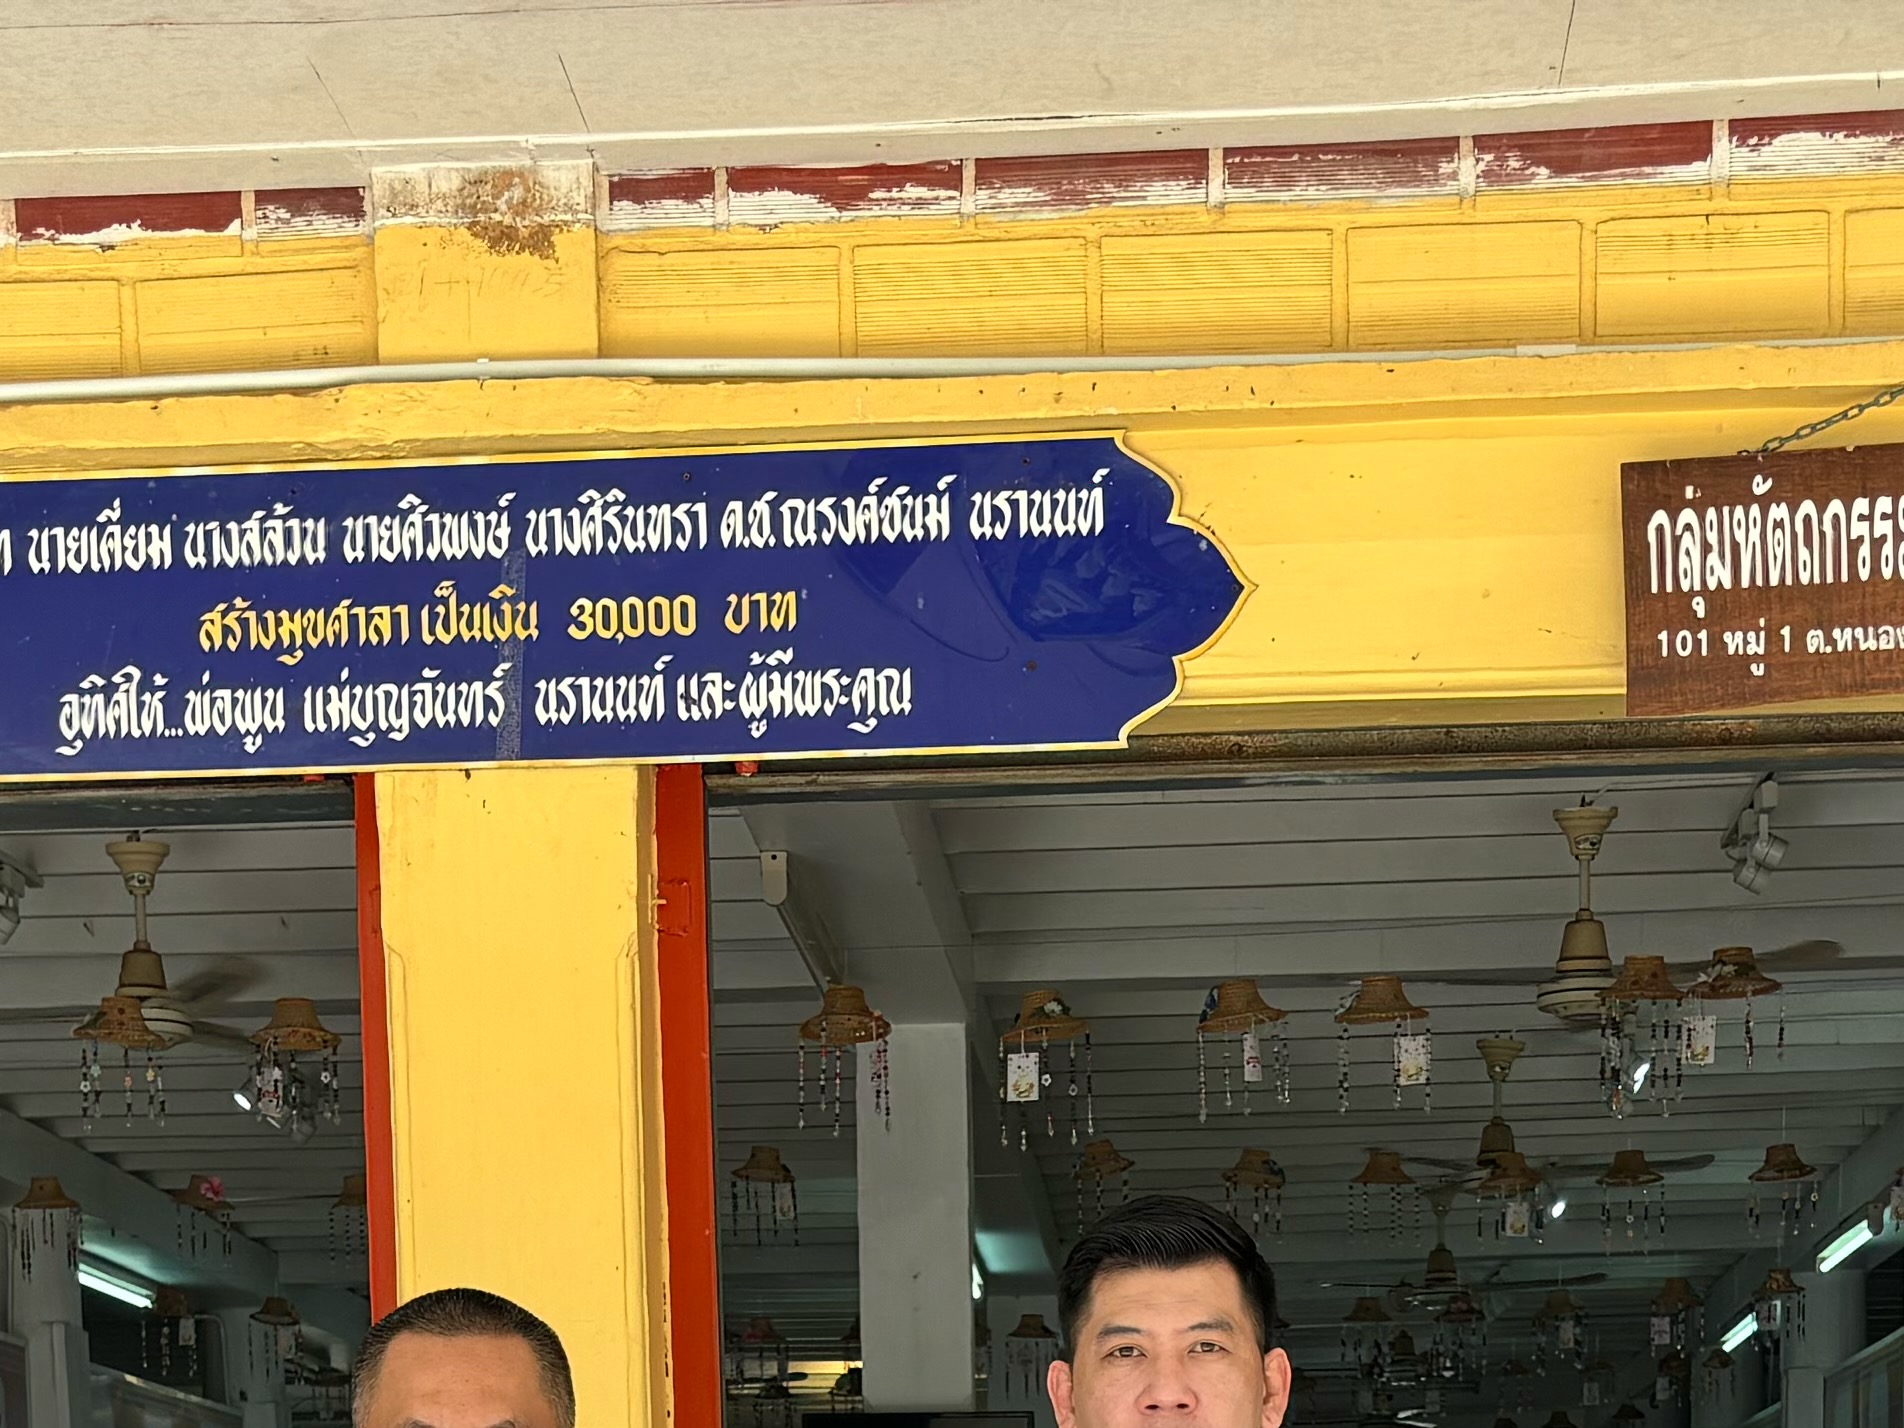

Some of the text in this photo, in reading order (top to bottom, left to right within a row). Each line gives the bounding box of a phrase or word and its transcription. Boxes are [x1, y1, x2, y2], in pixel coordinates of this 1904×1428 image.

[343, 492, 516, 564] นายศิวพงษ์
[969, 468, 1110, 541] นรานนท์
[198, 580, 798, 665] สร้างมุขศาลา เป็นเงิน 30,000 บาท
[1657, 629, 1710, 658] 101
[1723, 618, 1768, 676] หมู่
[1782, 626, 1793, 653] 1
[304, 662, 513, 749] แม่บุญจันทร์
[535, 655, 675, 726] นรานนท์
